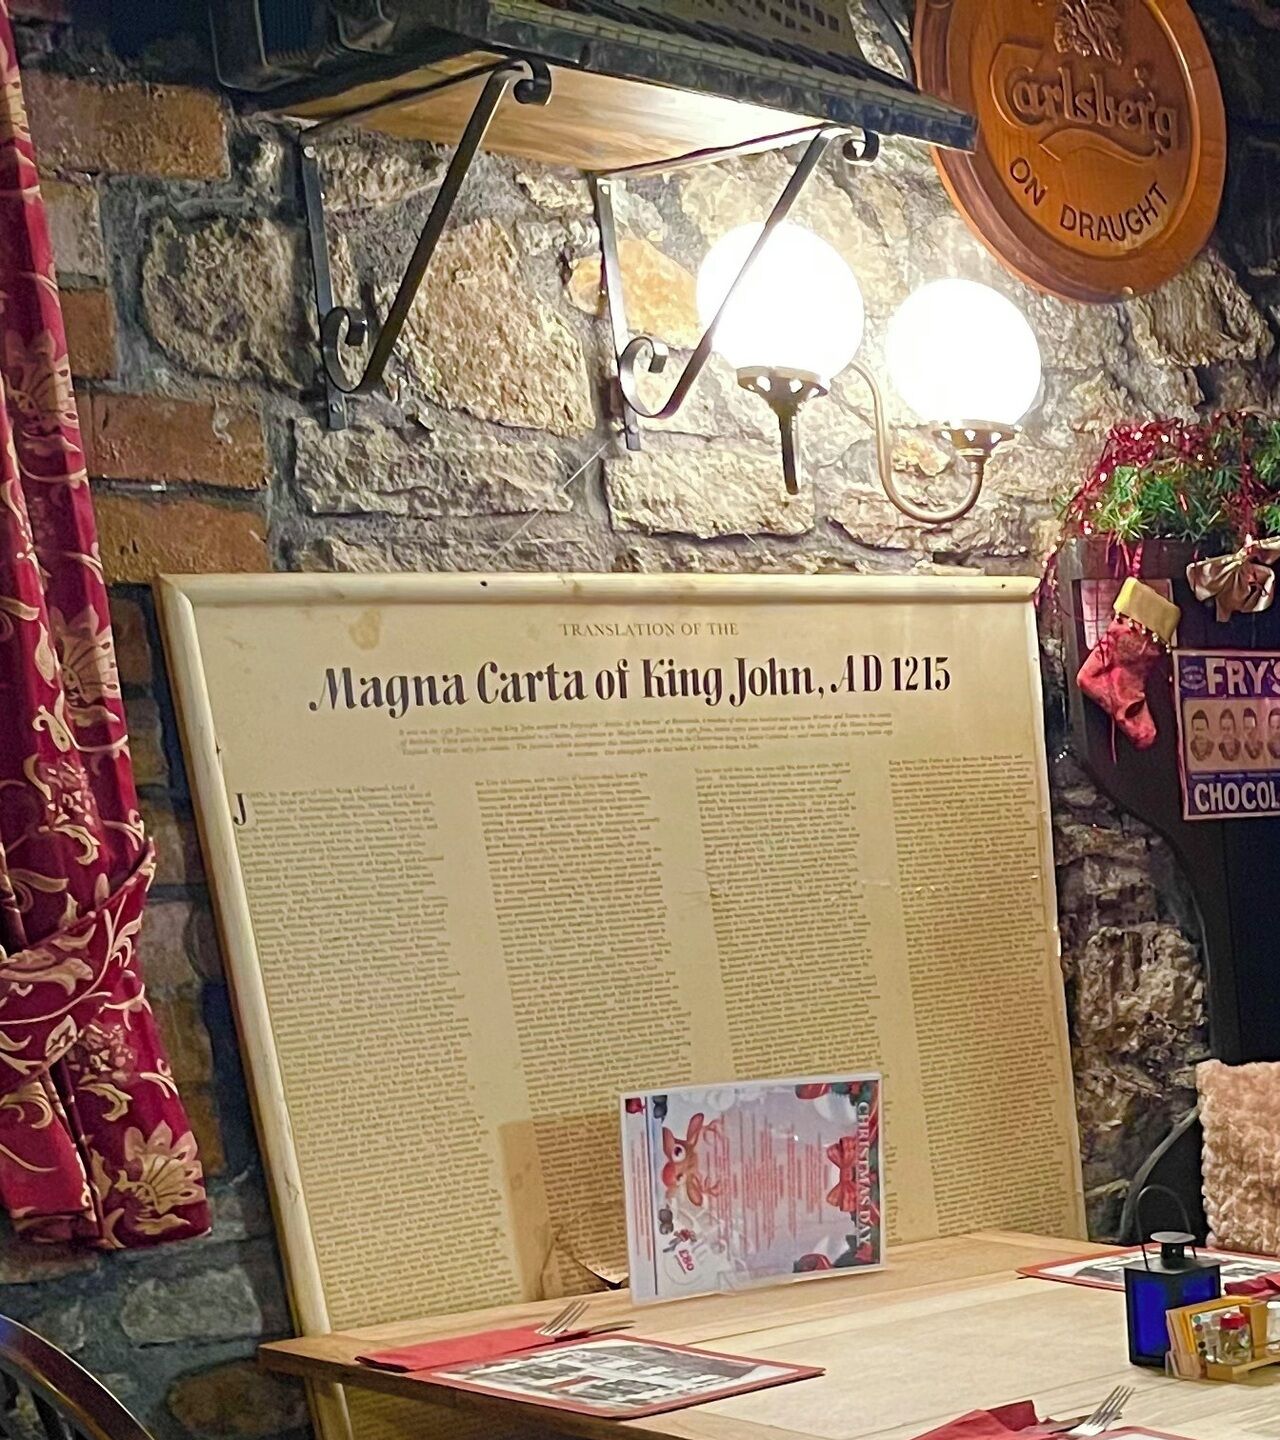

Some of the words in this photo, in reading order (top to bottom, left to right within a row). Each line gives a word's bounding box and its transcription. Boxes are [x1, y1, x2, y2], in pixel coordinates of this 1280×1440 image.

[989, 42, 1178, 155] Carlsberg
[1009, 156, 1046, 207] ON
[1059, 181, 1168, 242] DRAUGHT
[559, 622, 675, 637] TRANSLATION
[680, 622, 701, 636] OF
[706, 622, 739, 636] THE
[309, 666, 469, 720] Magna
[476, 661, 588, 705] Carta
[595, 658, 631, 700] of
[640, 657, 722, 707] King
[729, 656, 825, 707] John,
[830, 654, 882, 693] AD
[891, 656, 950, 692] 1215
[859, 1210, 872, 1246] DAY
